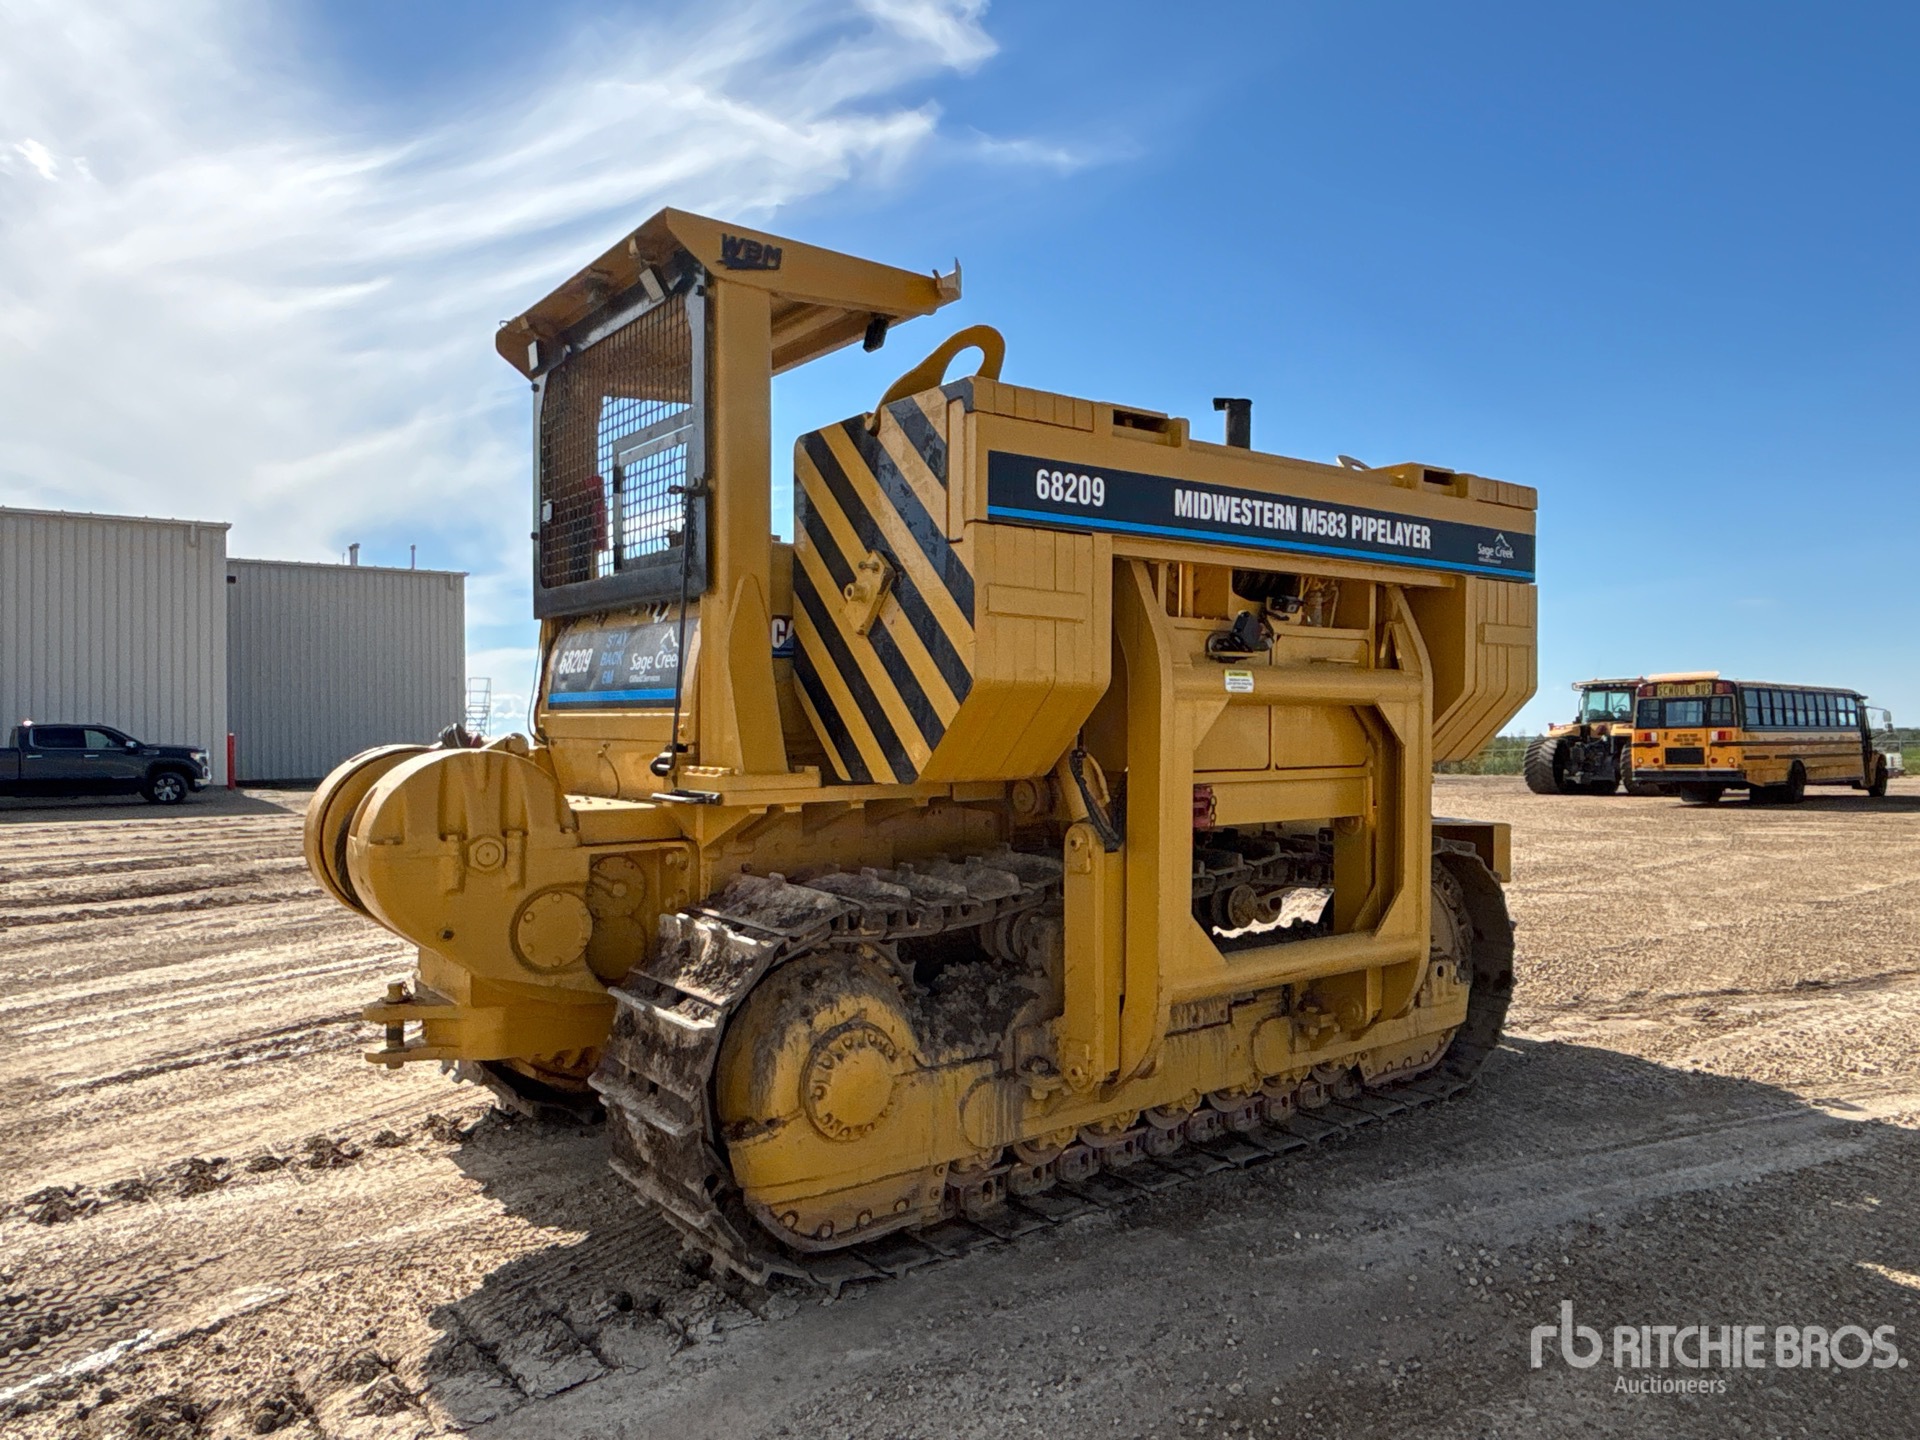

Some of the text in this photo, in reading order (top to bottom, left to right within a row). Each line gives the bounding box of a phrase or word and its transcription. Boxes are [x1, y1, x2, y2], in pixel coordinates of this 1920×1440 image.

[1036, 469, 1105, 507] 68209
[1174, 488, 1431, 549] MIDWESTERN M583 PIPELAYER
[560, 648, 593, 674] 68209
[630, 652, 653, 675] Sage
[1658, 684, 1711, 696] SCHOOL BUS
